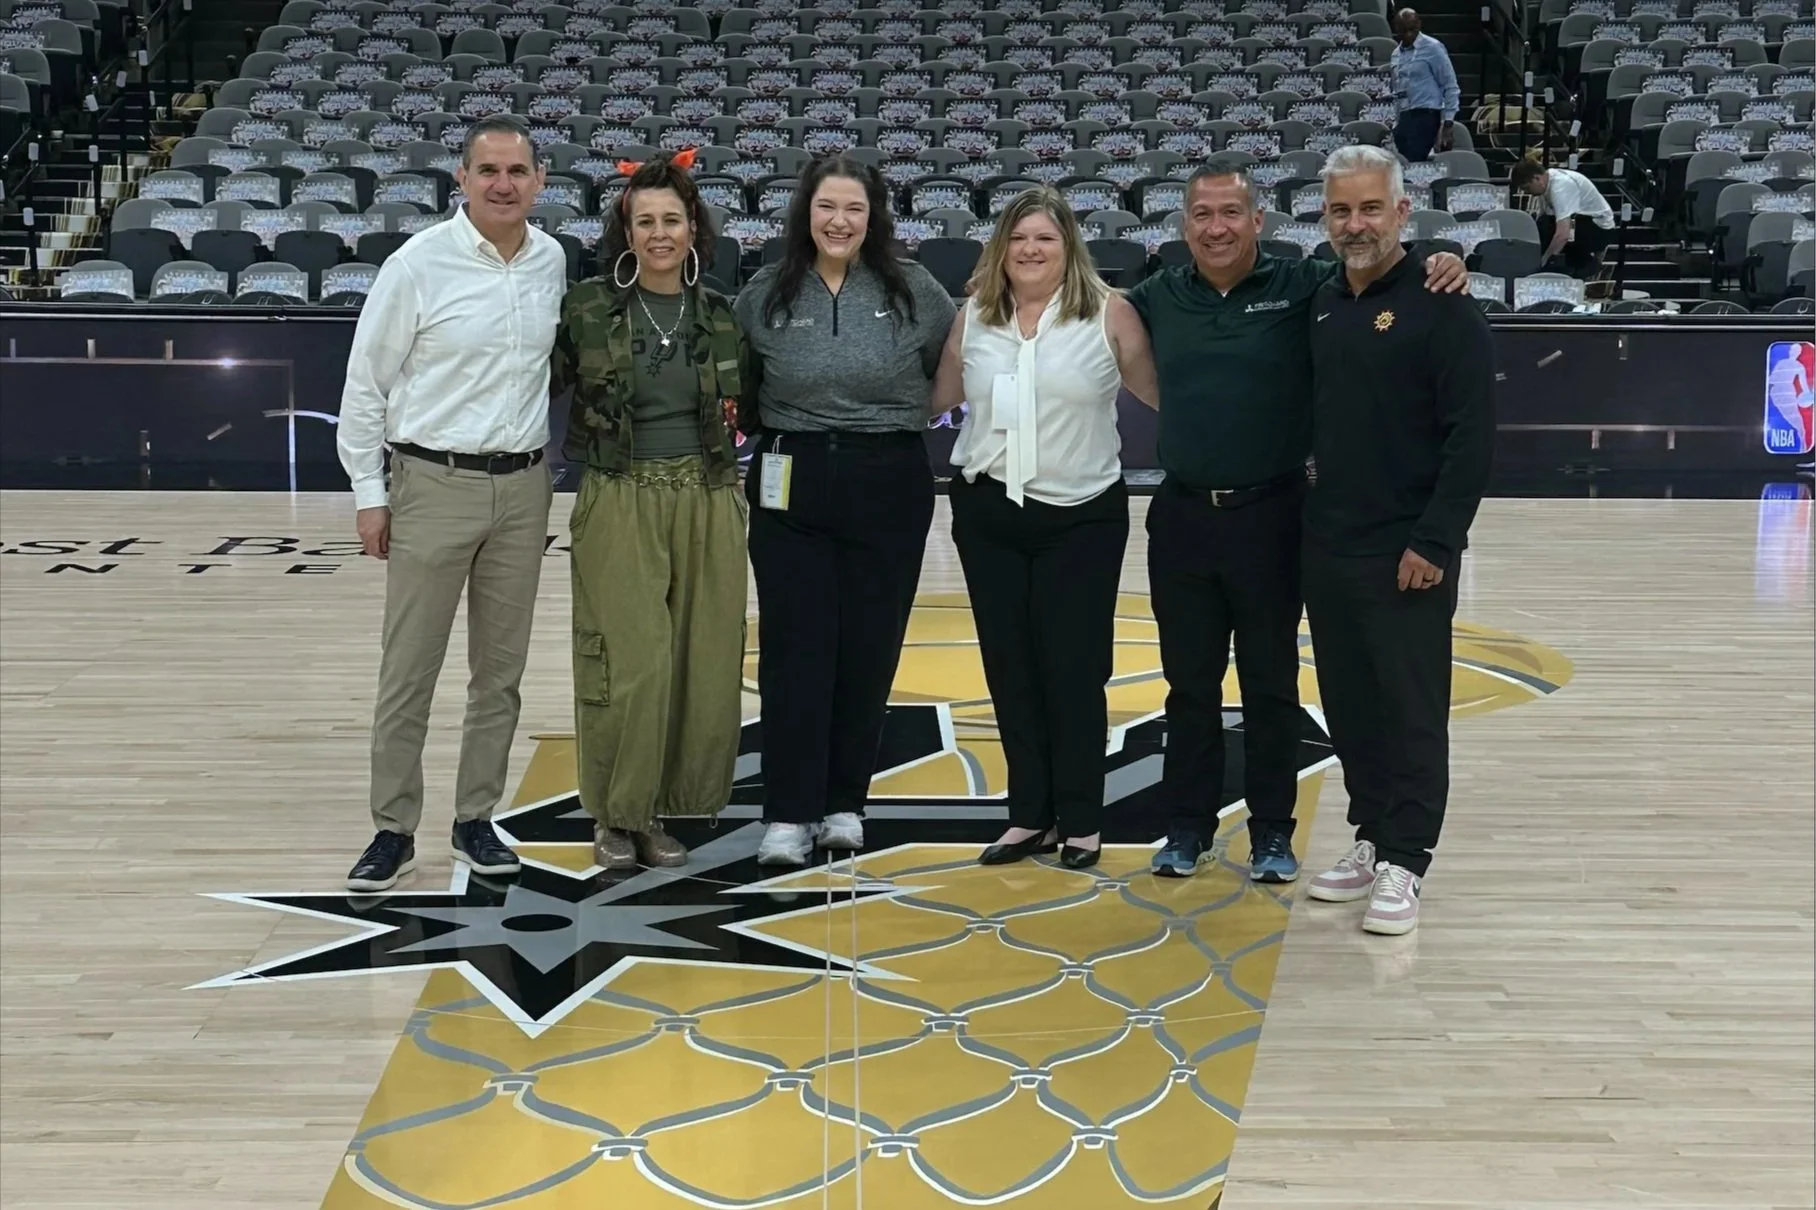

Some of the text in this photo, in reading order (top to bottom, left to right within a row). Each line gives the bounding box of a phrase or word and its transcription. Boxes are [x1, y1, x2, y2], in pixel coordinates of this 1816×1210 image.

[1771, 429, 1795, 447] NBA
[0, 538, 163, 555] st
[45, 564, 341, 574] NTE
